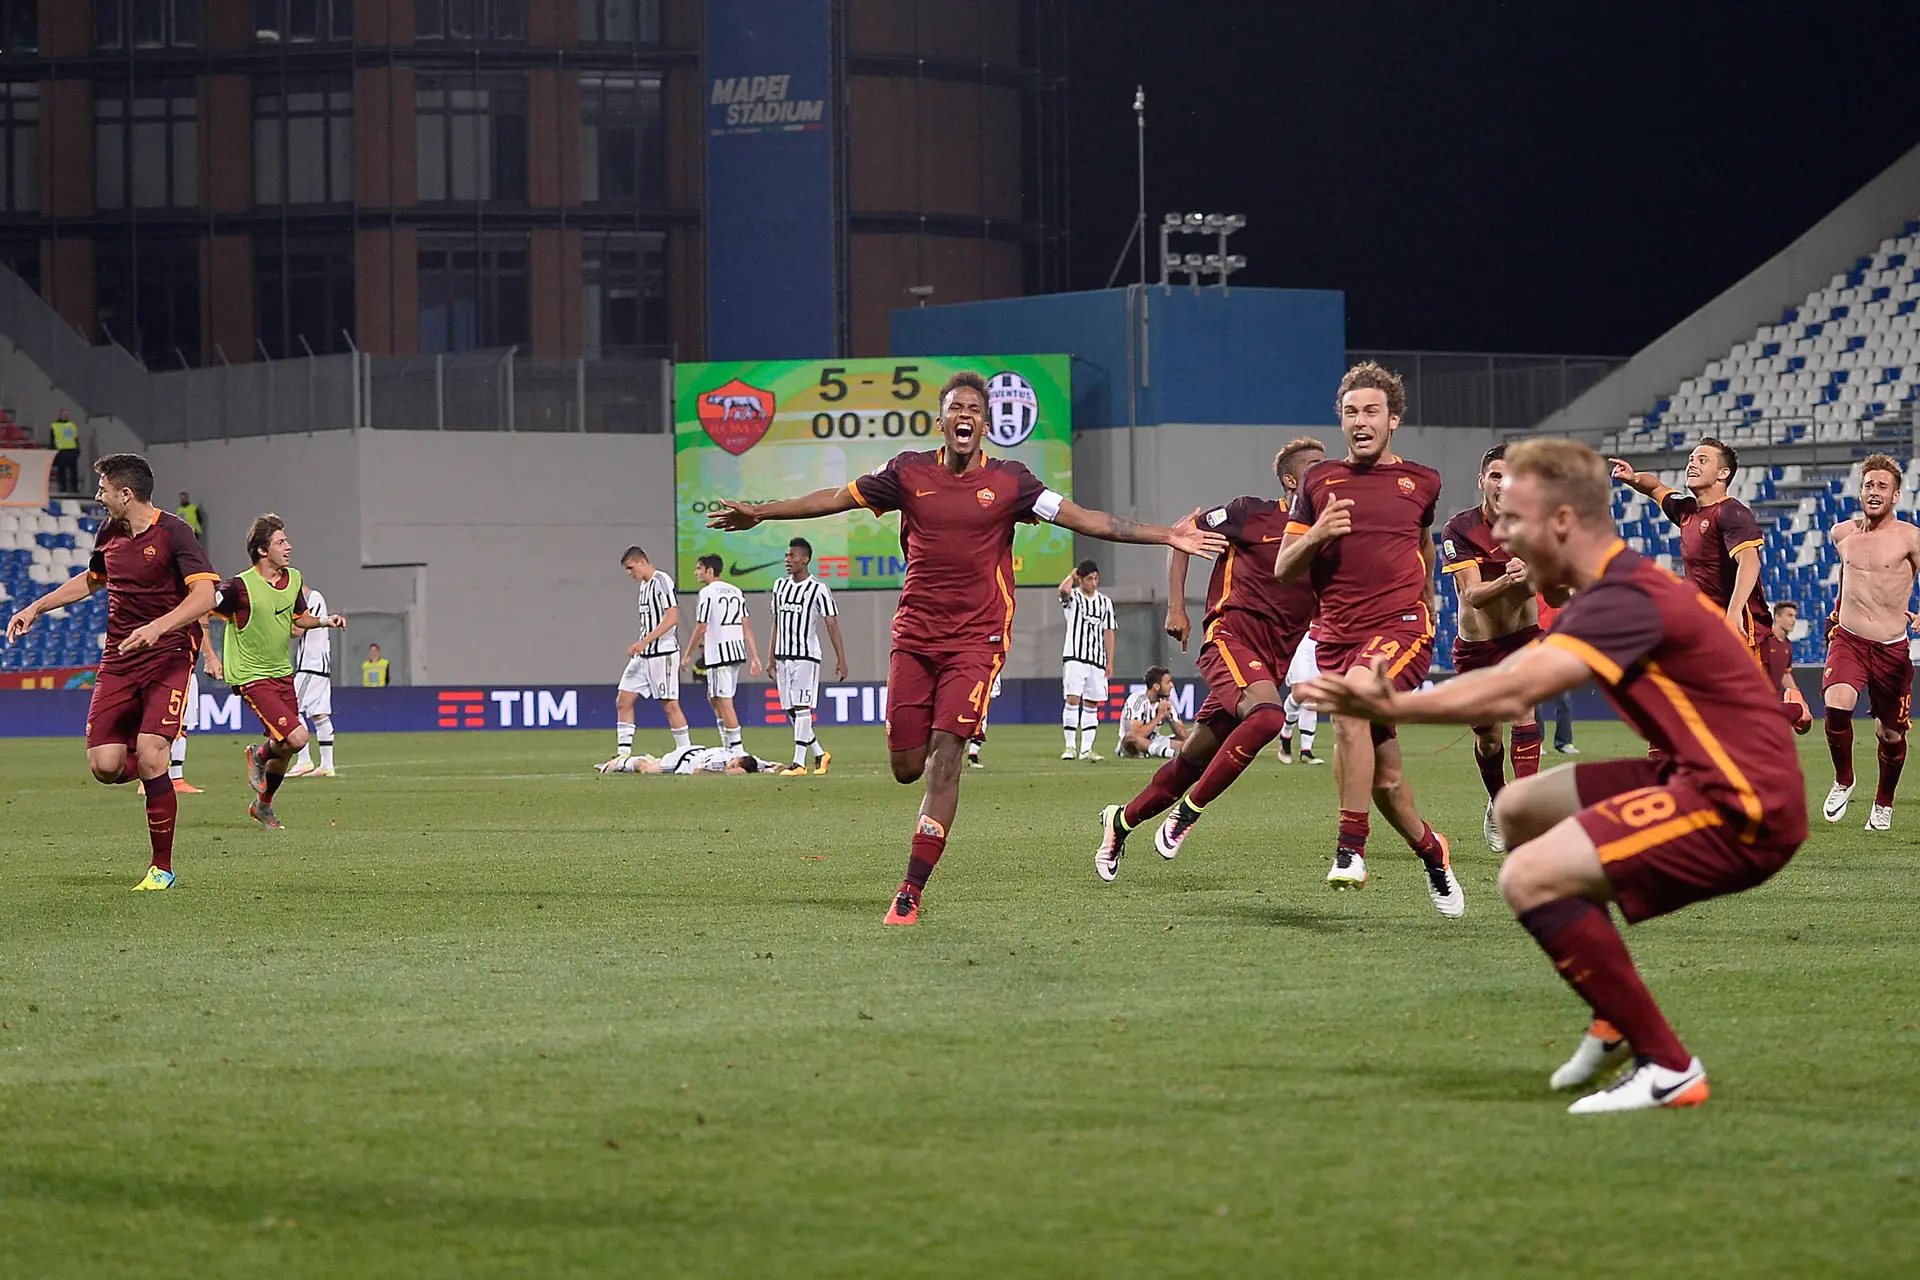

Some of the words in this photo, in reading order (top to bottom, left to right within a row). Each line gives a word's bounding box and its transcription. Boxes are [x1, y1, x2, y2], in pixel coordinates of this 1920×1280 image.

[712, 74, 790, 104] MAPEI
[726, 100, 824, 125] STADIUM
[819, 368, 847, 402] 5
[892, 365, 920, 400] 5
[812, 410, 931, 439] 00:00
[719, 596, 742, 626] 22
[1368, 635, 1400, 660] 14
[168, 689, 182, 716] 5
[659, 682, 666, 696] 9
[799, 689, 812, 704] 15
[968, 680, 985, 712] 4
[491, 688, 578, 727] TIM
[825, 686, 888, 723] TI
